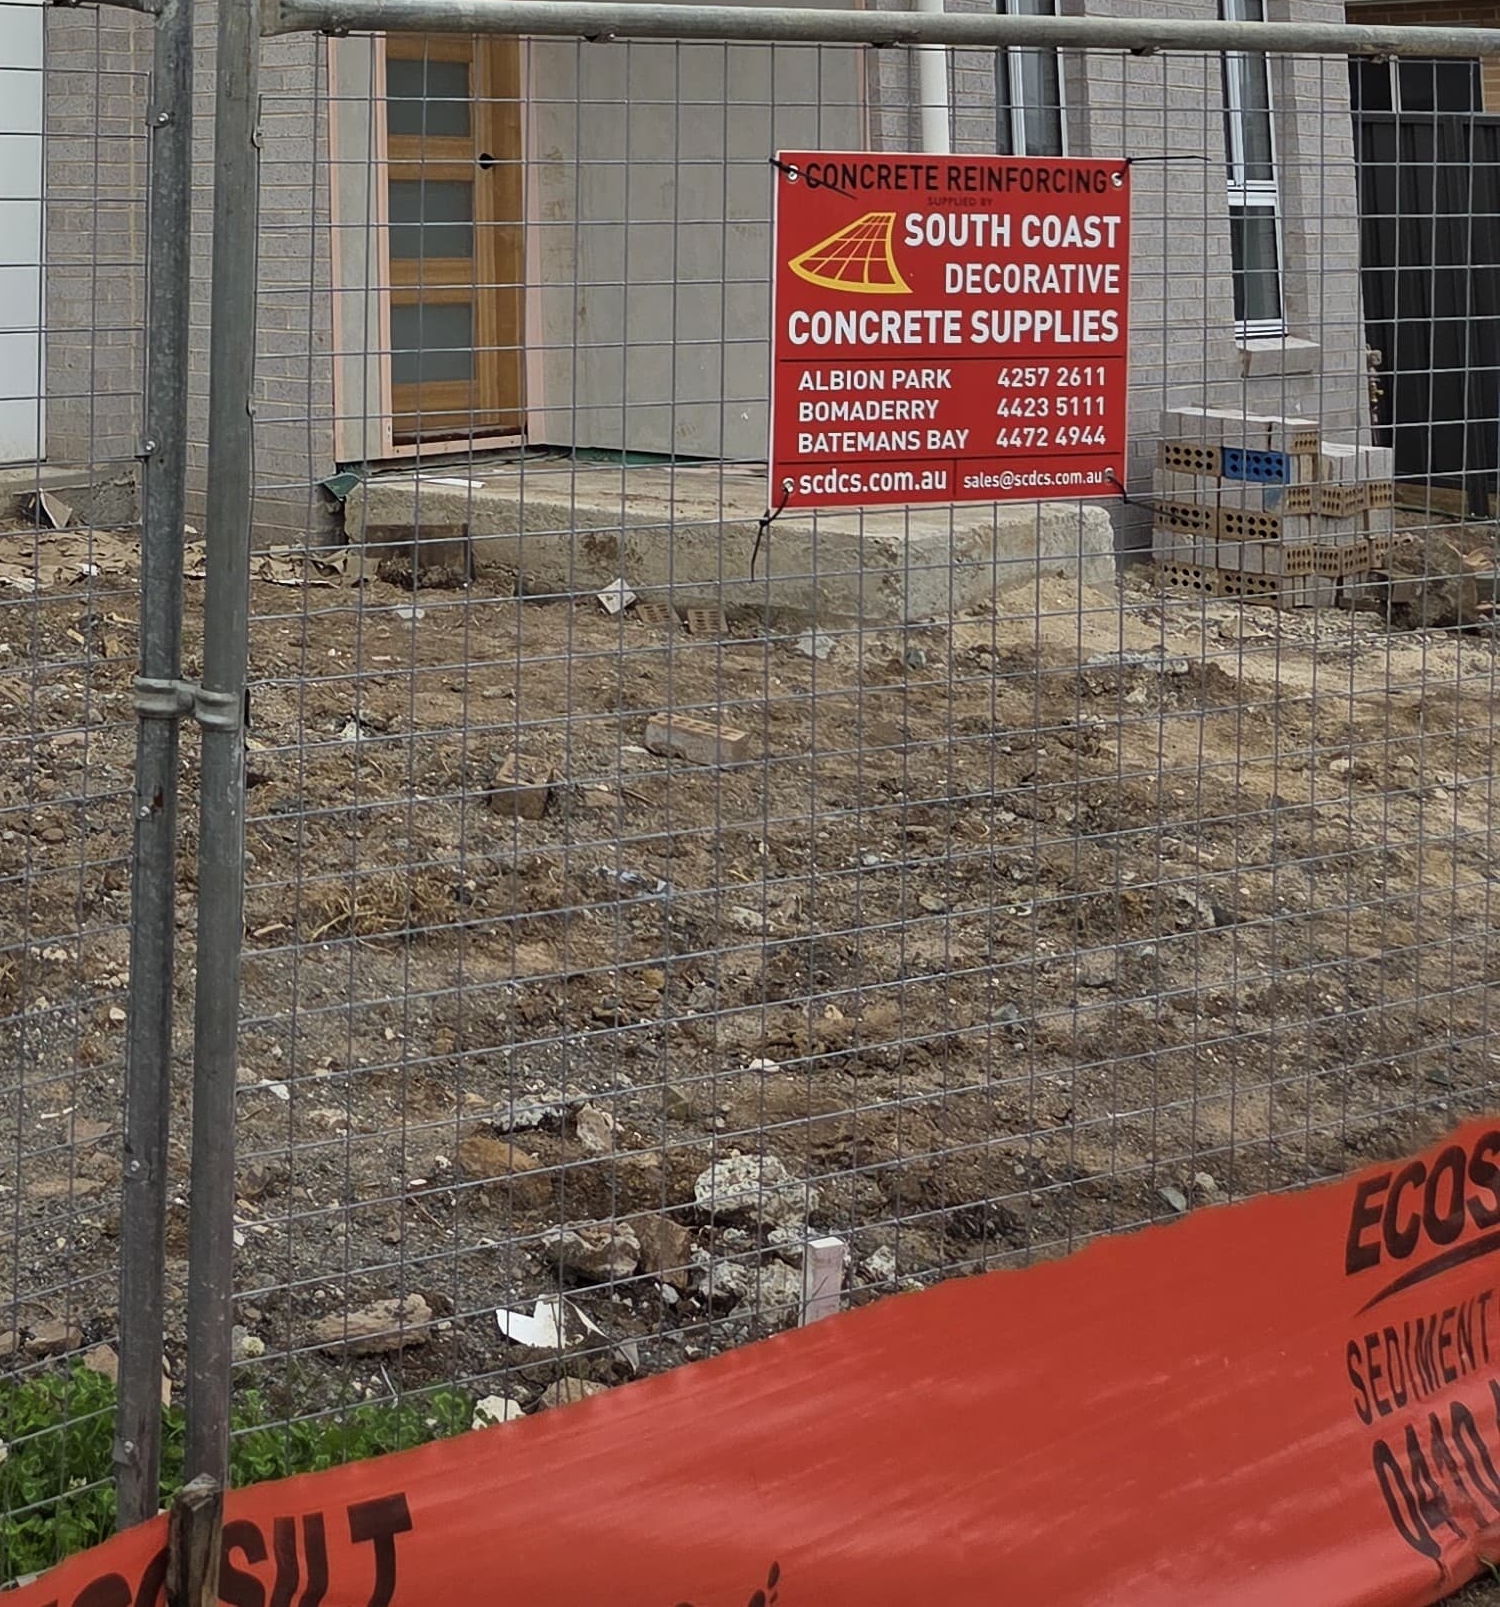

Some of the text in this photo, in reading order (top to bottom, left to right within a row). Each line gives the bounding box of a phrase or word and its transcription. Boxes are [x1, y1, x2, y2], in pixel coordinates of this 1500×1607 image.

[806, 163, 1107, 193] CONCRETE REINFORCING
[927, 196, 993, 207] SUPPLIED BY
[904, 212, 1122, 249] SOUTH COAST
[945, 263, 1121, 294] DECORATIVE
[788, 309, 1119, 345] CONCRETE SUPPLIES
[798, 366, 1105, 391] ALBION PARK 4257 2611
[798, 396, 1105, 422] BOMADERRY 4423 5111
[798, 425, 1106, 454] BATEMANS BAY 4472 4944
[799, 468, 1102, 495] scdcs.com.au sales@scdcs.com.au
[1347, 1289, 1493, 1425] SEDIMENT
